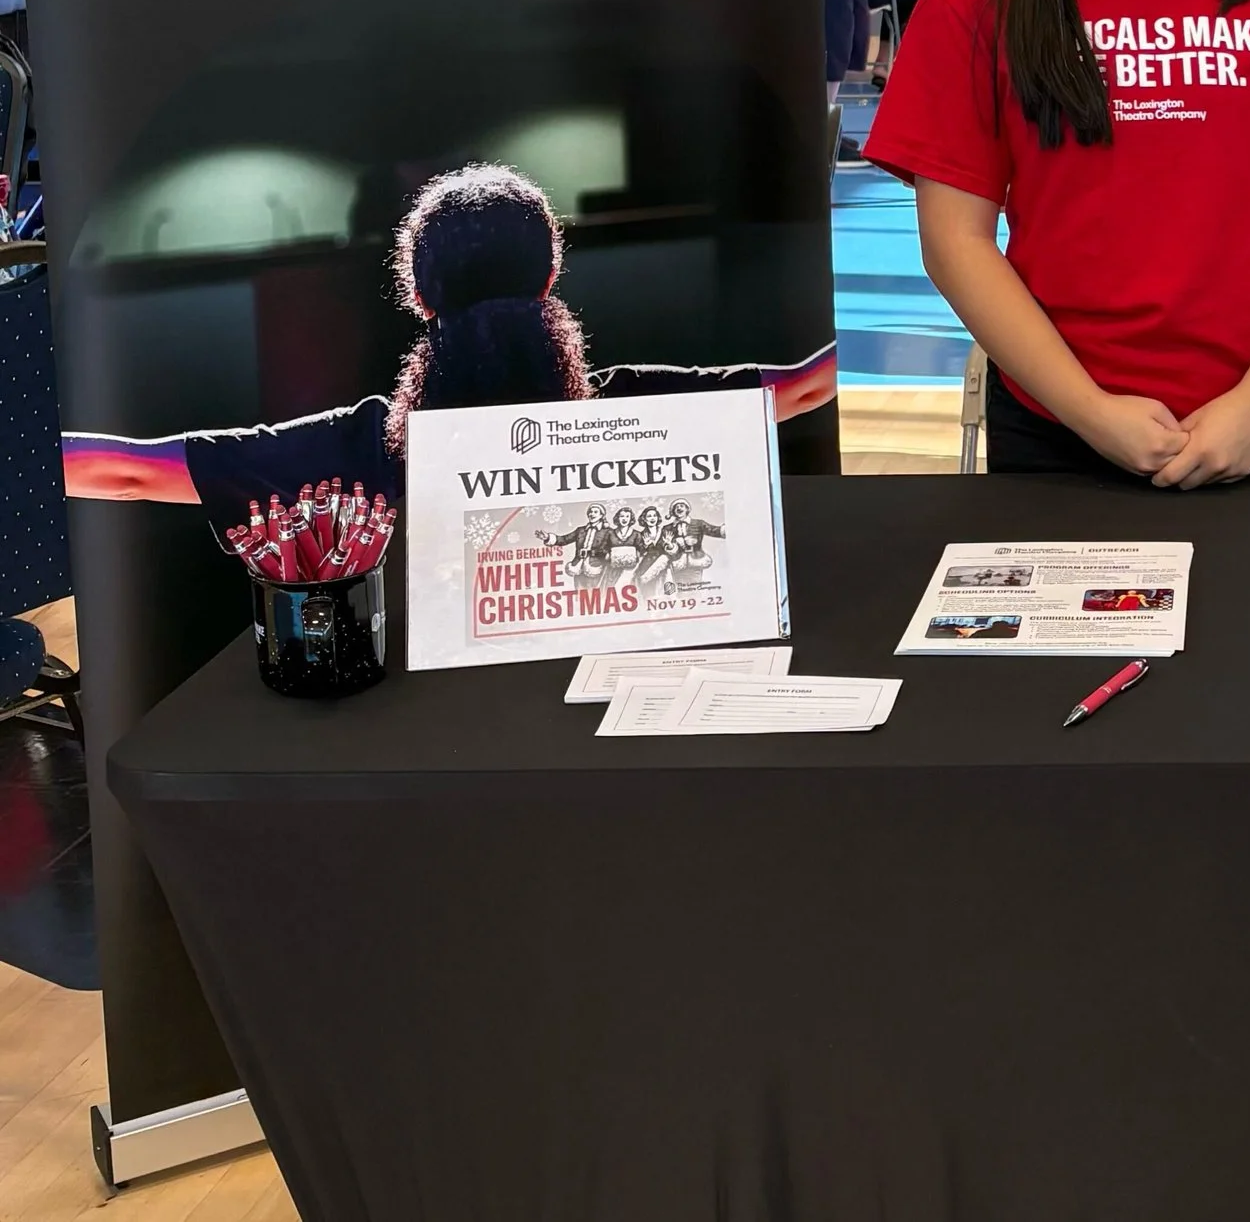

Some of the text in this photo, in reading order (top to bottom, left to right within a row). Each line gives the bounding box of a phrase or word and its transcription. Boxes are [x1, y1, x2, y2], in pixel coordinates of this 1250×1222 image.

[1083, 17, 1175, 50] ICALS
[1115, 51, 1246, 87] BETTER.
[1113, 98, 1184, 112] The Lexington
[1113, 109, 1207, 122] Theatre Company
[547, 417, 640, 433] The Lexington
[547, 429, 668, 446] Theatre Company
[458, 453, 722, 499] WIN TICKETS!
[478, 545, 564, 563] IRVING BERLIN'S
[478, 560, 564, 593] WHITE
[479, 585, 638, 625] CHRISTMAS
[647, 599, 677, 611] Nov
[681, 598, 697, 610] 19
